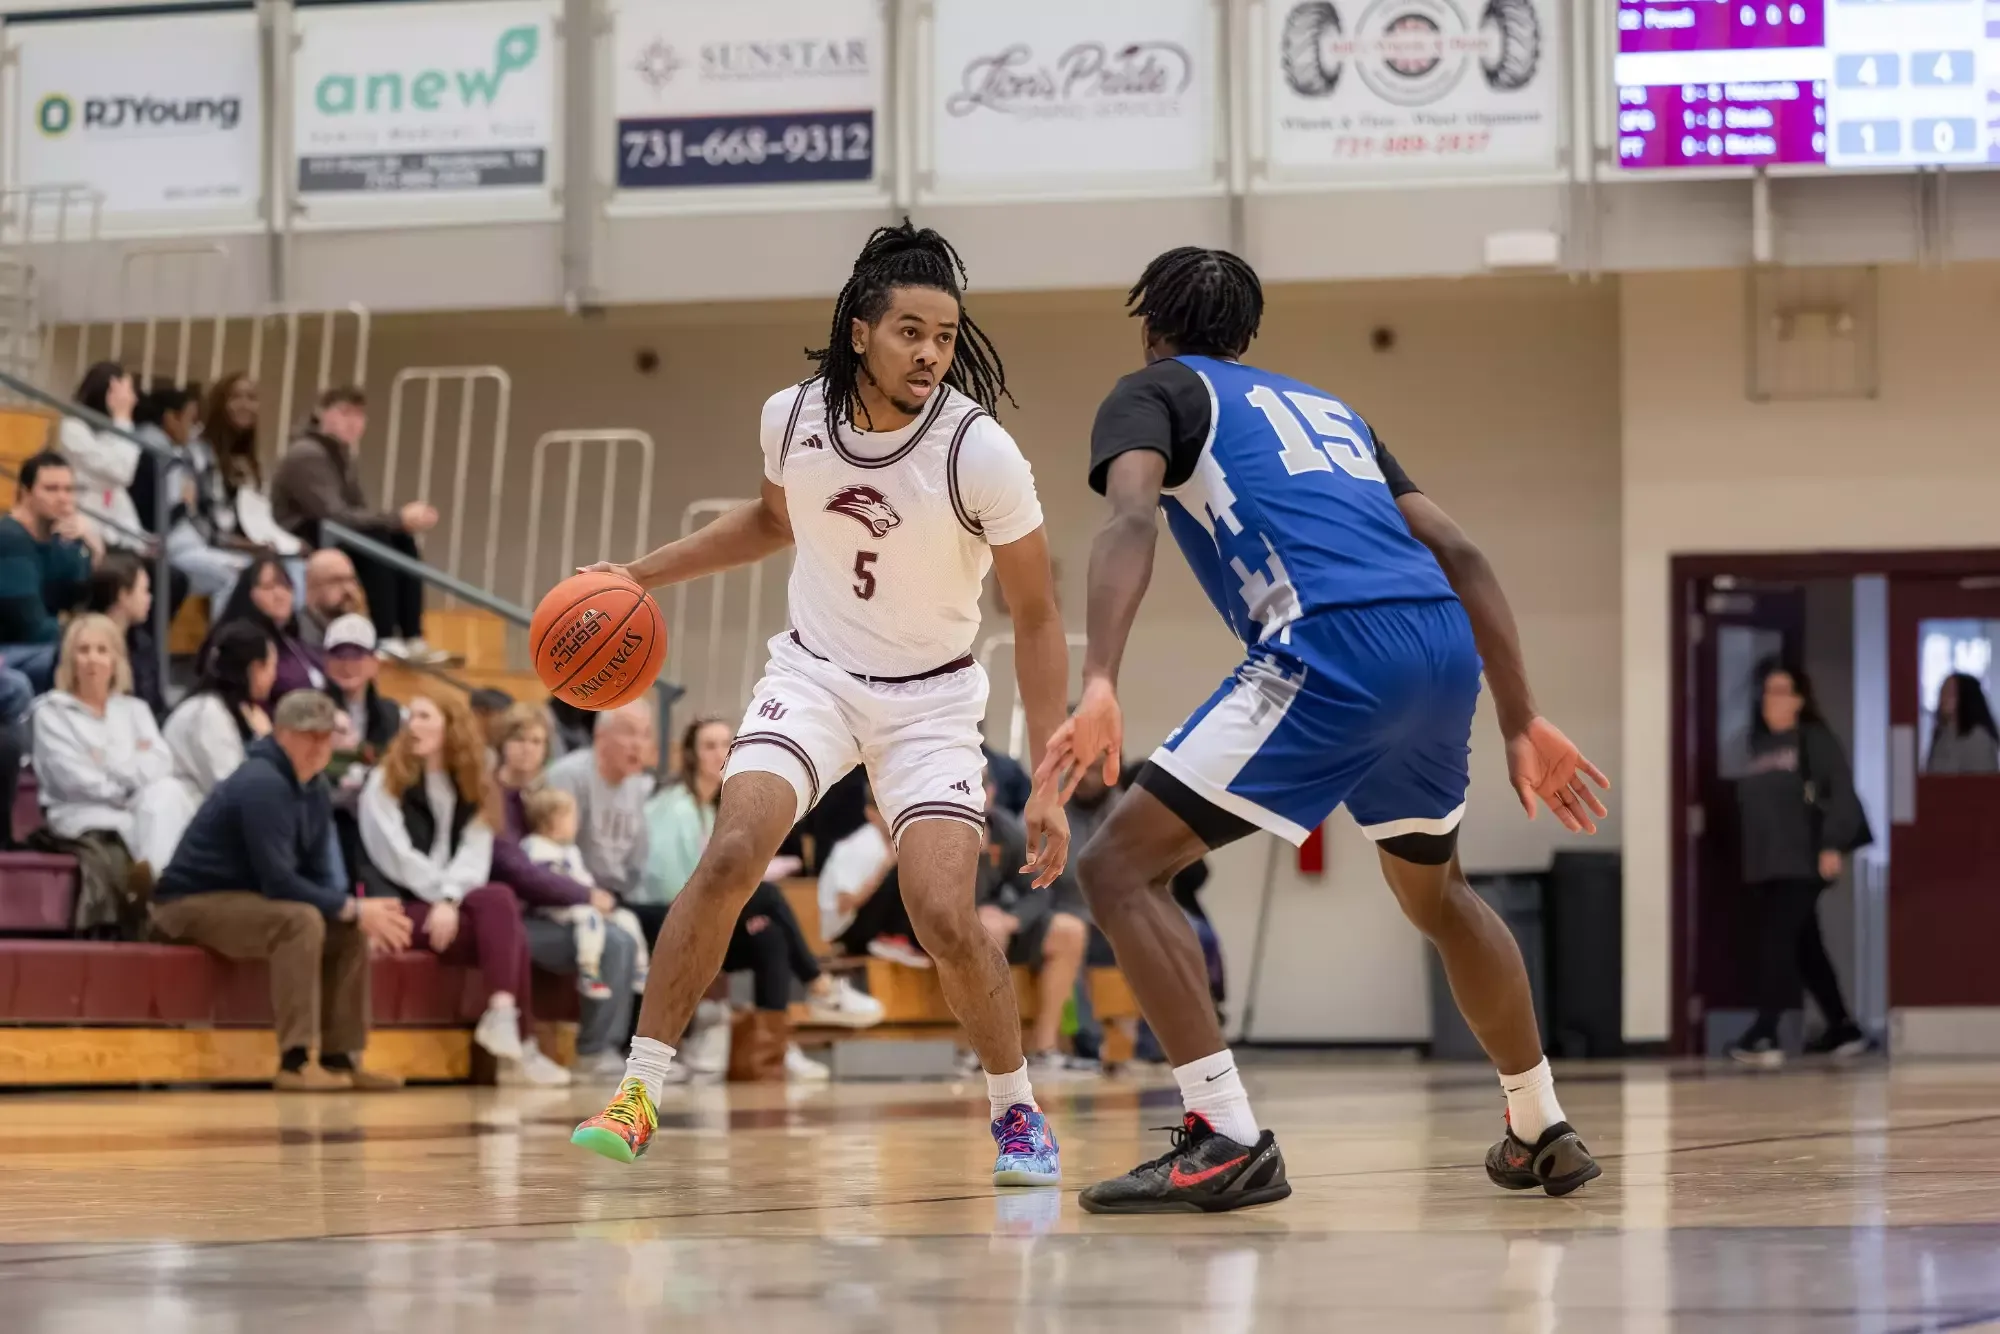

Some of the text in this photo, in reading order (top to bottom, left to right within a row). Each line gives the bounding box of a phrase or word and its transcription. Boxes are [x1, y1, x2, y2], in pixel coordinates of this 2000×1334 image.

[701, 38, 868, 70] SUNSTAR
[1857, 52, 1953, 85] 4 4
[84, 93, 241, 131] RJYoung
[315, 66, 508, 115] anew
[623, 123, 870, 168] 731-668-9312
[1860, 124, 1875, 152] 1
[1933, 121, 1954, 152] 0
[1245, 385, 1386, 484] 15
[852, 550, 878, 601] 5
[554, 611, 611, 673] LEGACY
[569, 627, 643, 700] SPALDING
